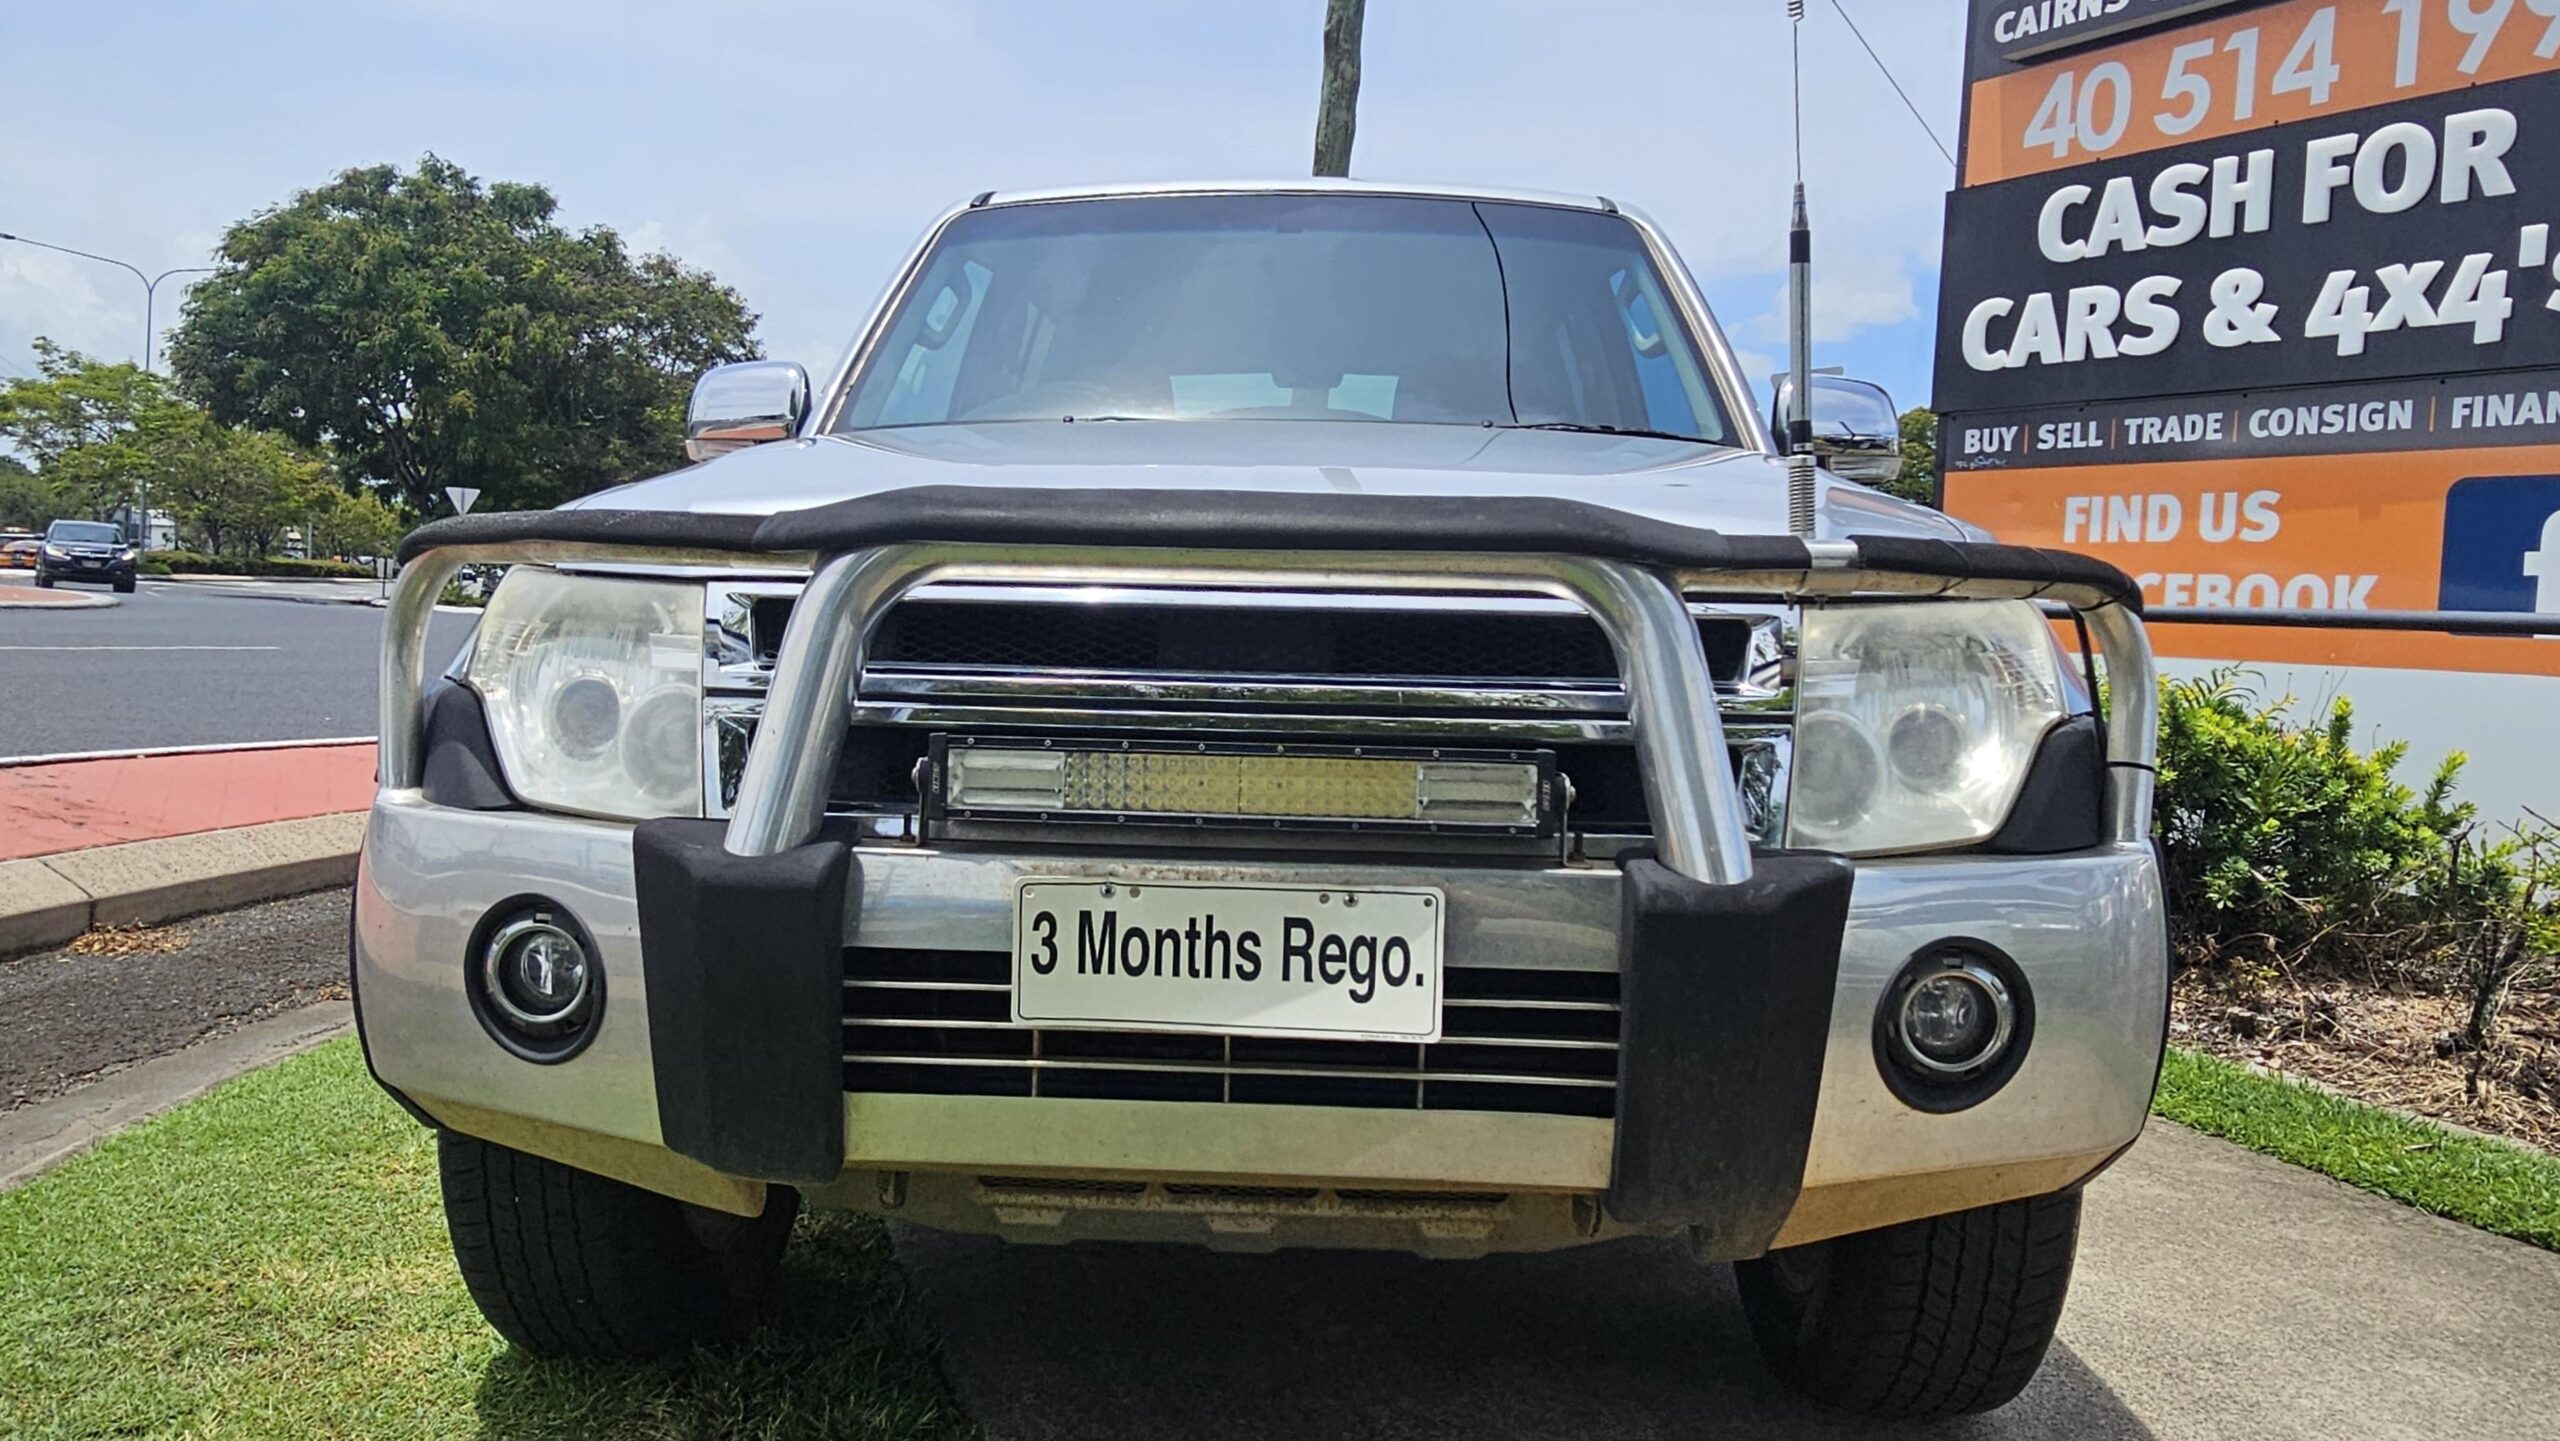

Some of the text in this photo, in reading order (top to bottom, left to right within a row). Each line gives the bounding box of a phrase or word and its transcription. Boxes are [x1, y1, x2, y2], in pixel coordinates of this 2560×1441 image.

[2022, 60, 2133, 159] 40
[2153, 7, 2339, 136] 514
[2037, 107, 2517, 263] CASH FOR
[1961, 275, 2183, 372] CARS
[2202, 267, 2282, 348] &
[1964, 425, 2019, 454] BUY
[2036, 420, 2104, 450] SELL
[2124, 412, 2223, 445] TRADE
[2248, 399, 2413, 439] CONSIGN
[2063, 489, 2281, 544] FIND US
[2136, 572, 2379, 610] CEBOOK
[1030, 909, 1424, 1004] 3 Months Rego.
